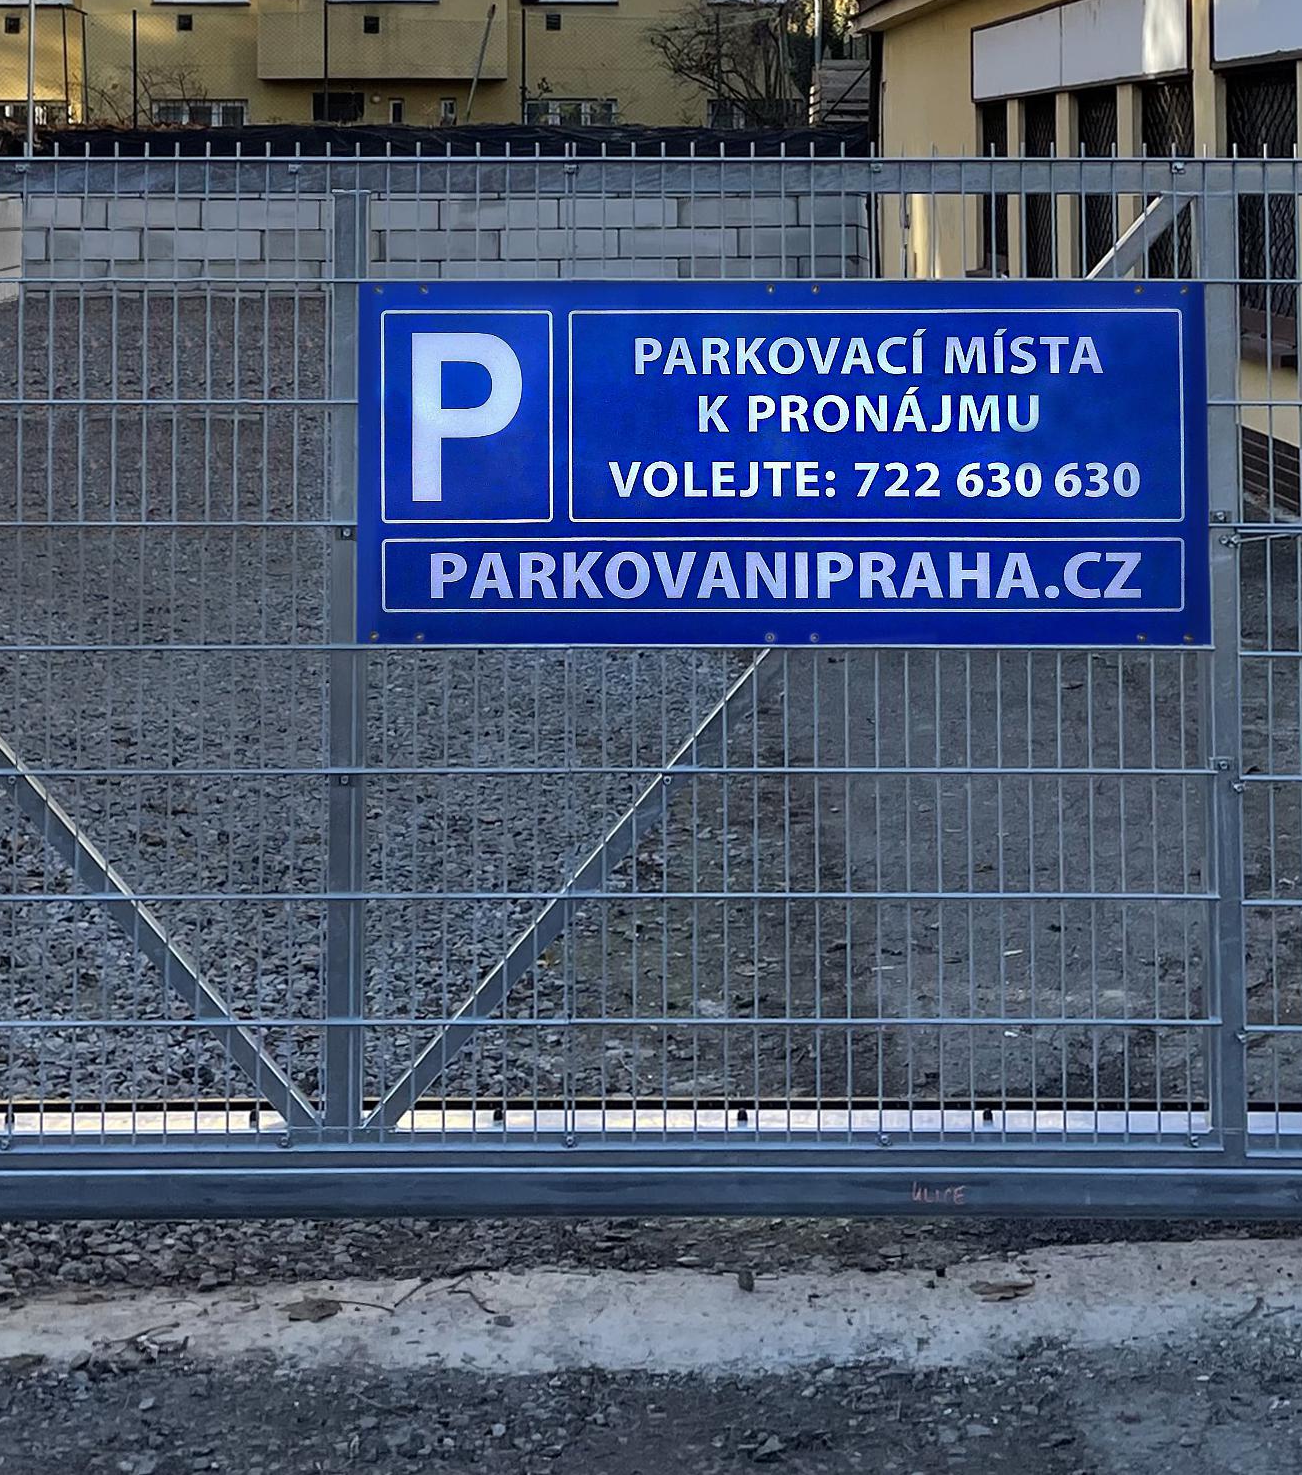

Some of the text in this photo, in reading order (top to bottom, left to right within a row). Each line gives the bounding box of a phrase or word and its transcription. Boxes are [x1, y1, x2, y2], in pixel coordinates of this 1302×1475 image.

[634, 328, 1104, 375] PARKOVACÍ MÍSTA
[411, 332, 523, 502] P
[698, 386, 1040, 433] K PRONÁJMU
[608, 461, 1141, 498] VOLEJTE: 722 630 630
[430, 551, 1142, 599] PARKOVANIPRAHA.CZ
